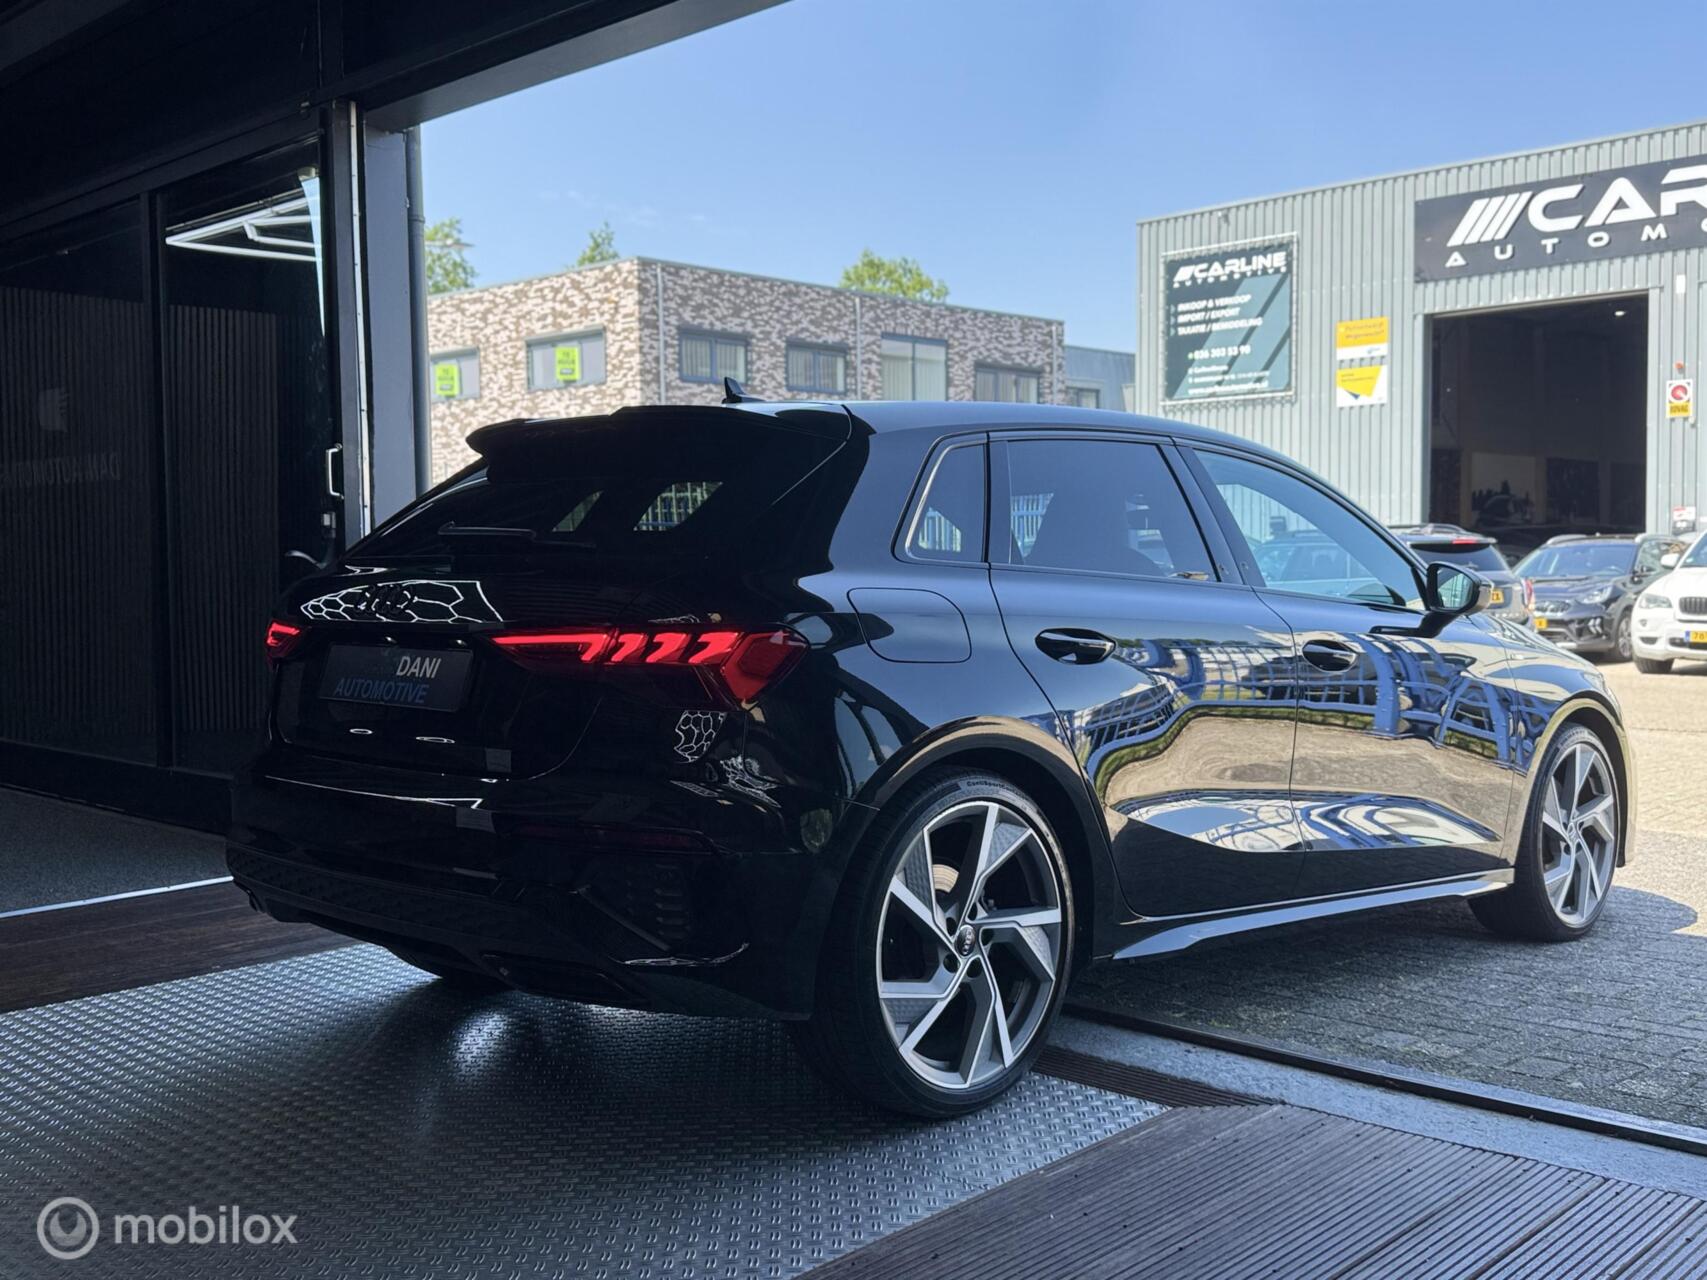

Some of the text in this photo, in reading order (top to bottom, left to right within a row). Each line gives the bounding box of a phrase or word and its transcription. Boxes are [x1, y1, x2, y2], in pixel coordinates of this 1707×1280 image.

[1445, 218, 1707, 268] AUTOM
[1194, 252, 1286, 278] CARLINE
[396, 655, 442, 679] DANI
[332, 678, 429, 704] AUTOMOTIVE
